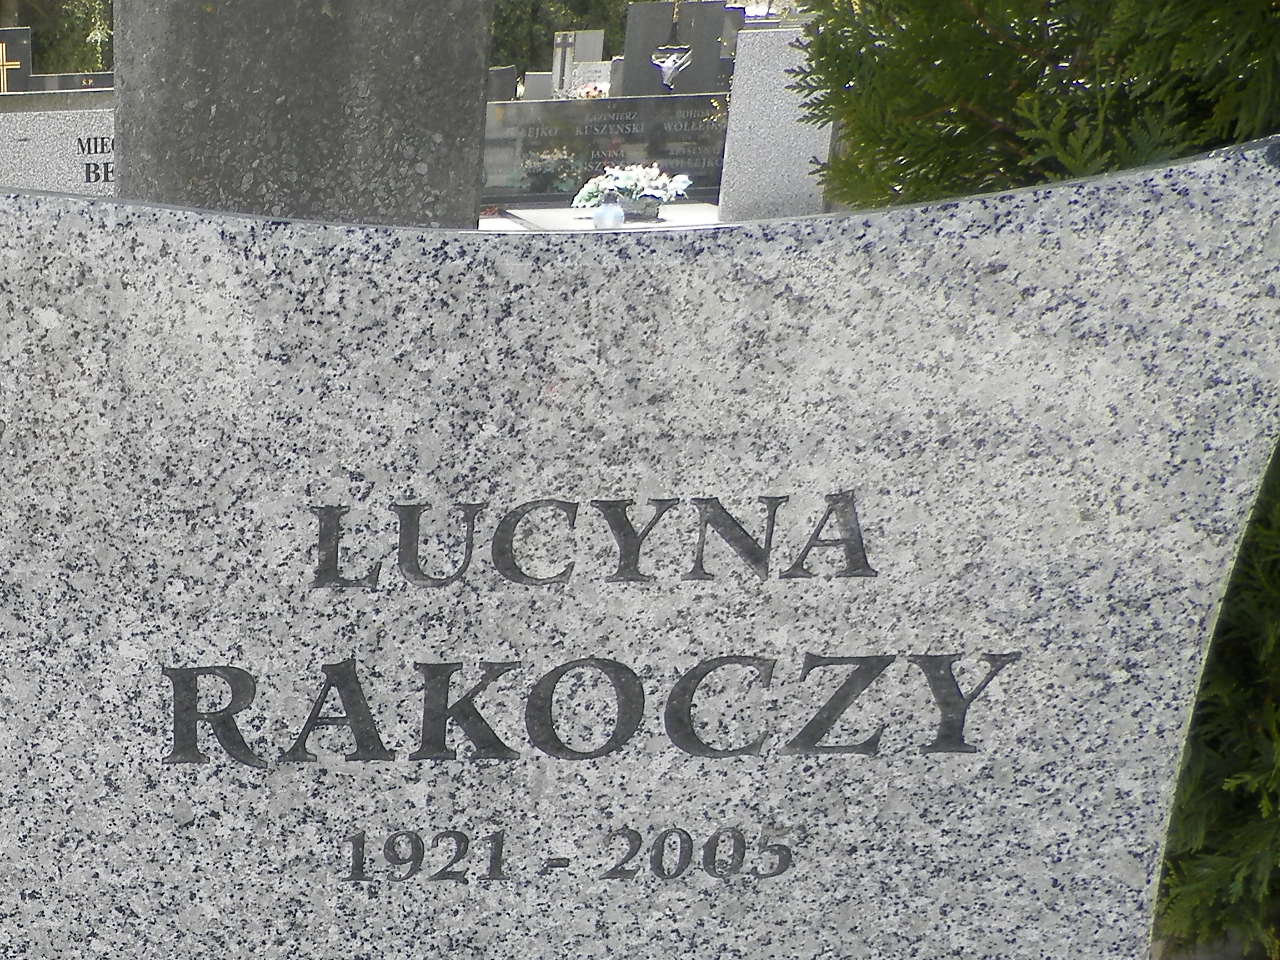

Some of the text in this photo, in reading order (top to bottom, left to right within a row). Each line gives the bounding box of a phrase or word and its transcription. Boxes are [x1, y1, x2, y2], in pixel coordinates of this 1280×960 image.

[76, 136, 114, 155] MIE
[312, 489, 879, 589] LUCYNA
[161, 650, 1022, 769] RAKOCZY
[343, 828, 509, 883] 1921
[601, 826, 794, 882] 2005
